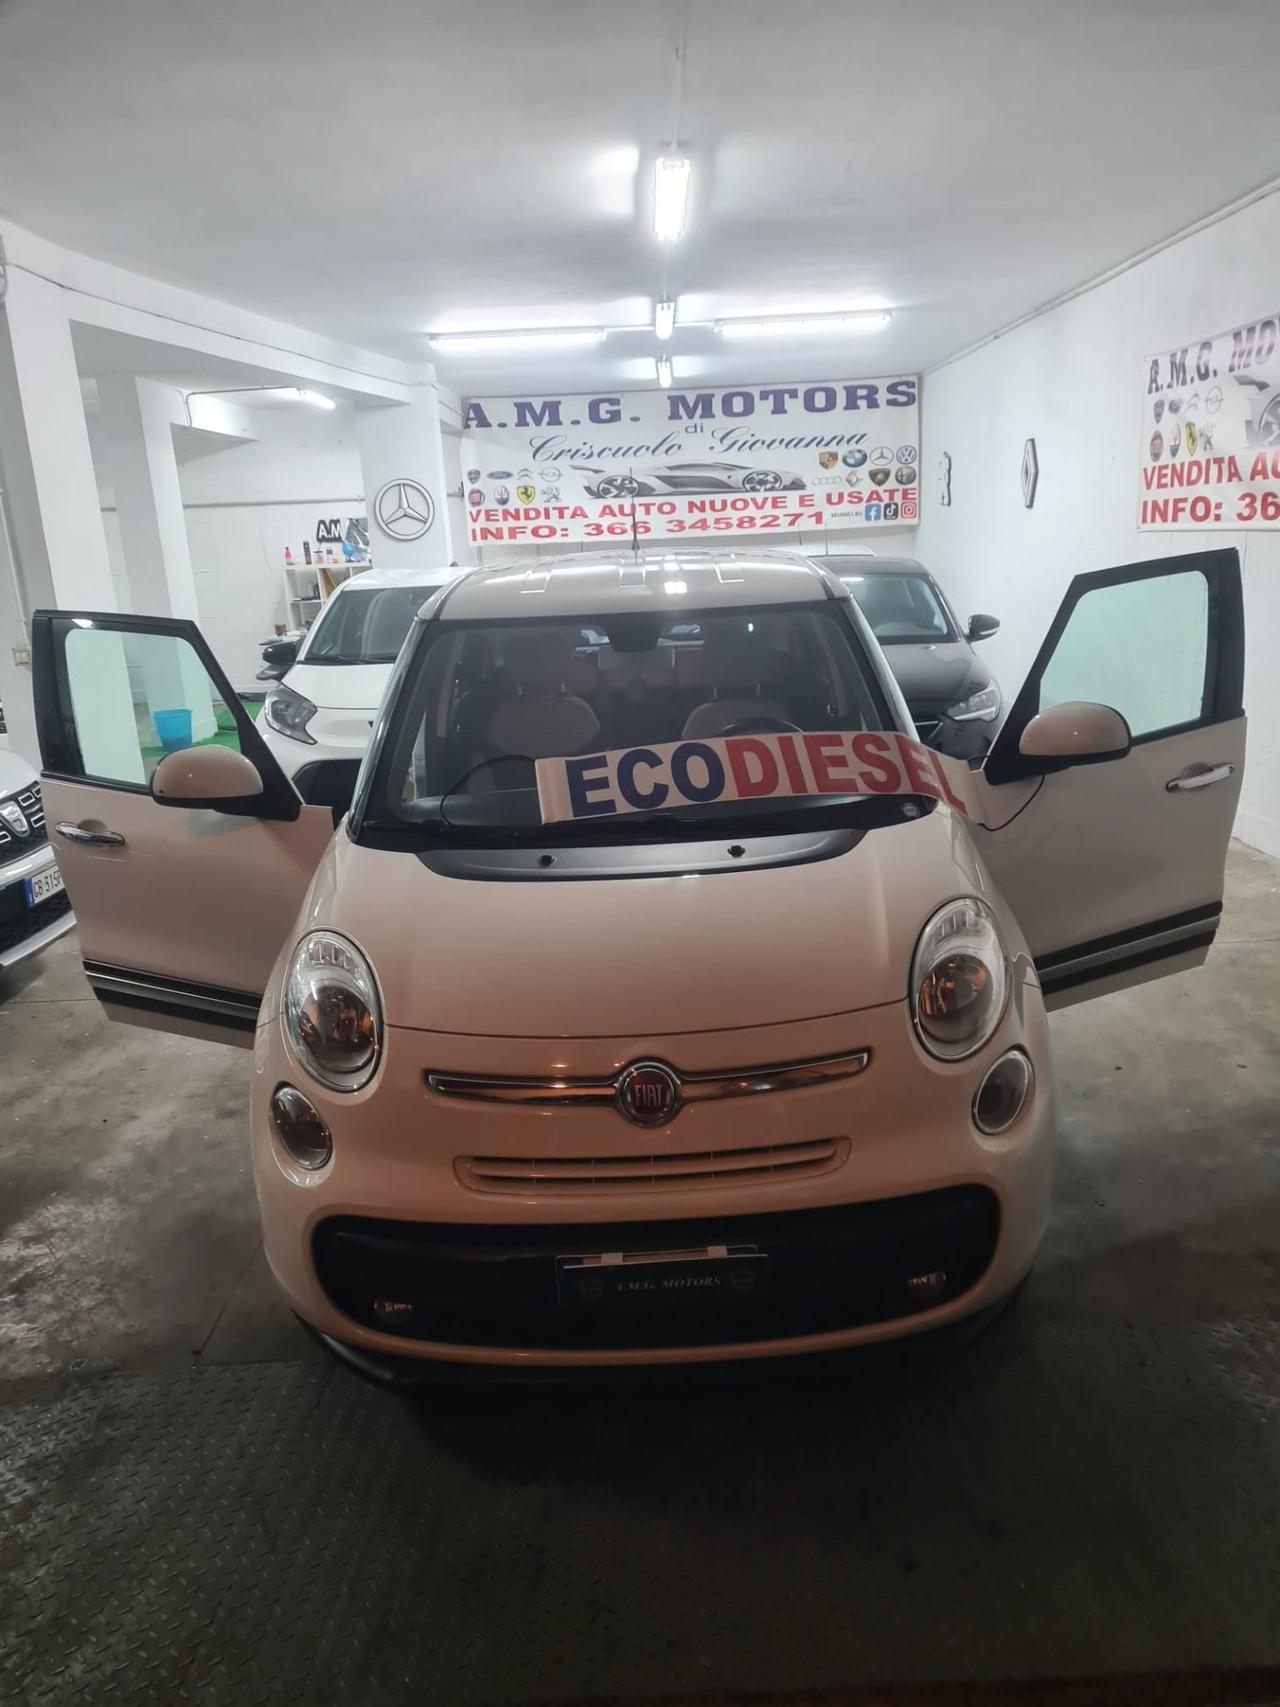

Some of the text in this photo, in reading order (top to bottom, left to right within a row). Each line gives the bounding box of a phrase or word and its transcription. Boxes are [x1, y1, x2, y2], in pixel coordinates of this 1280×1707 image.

[1147, 340, 1218, 395] A.M.G.
[463, 380, 917, 429] A.M.G. MOTORS
[529, 425, 869, 462] Criscuolo Giovanna
[684, 422, 705, 434] di
[1142, 454, 1243, 491] VENDITA
[469, 487, 917, 523] VENDITA AUTO NUOVE E USATE
[1141, 495, 1223, 524] INFO:
[471, 511, 824, 542] INFO: 366 3458271
[564, 731, 969, 819] ECODIESEL
[634, 1083, 664, 1107] FIAT
[660, 1276, 722, 1289] MOTORS
